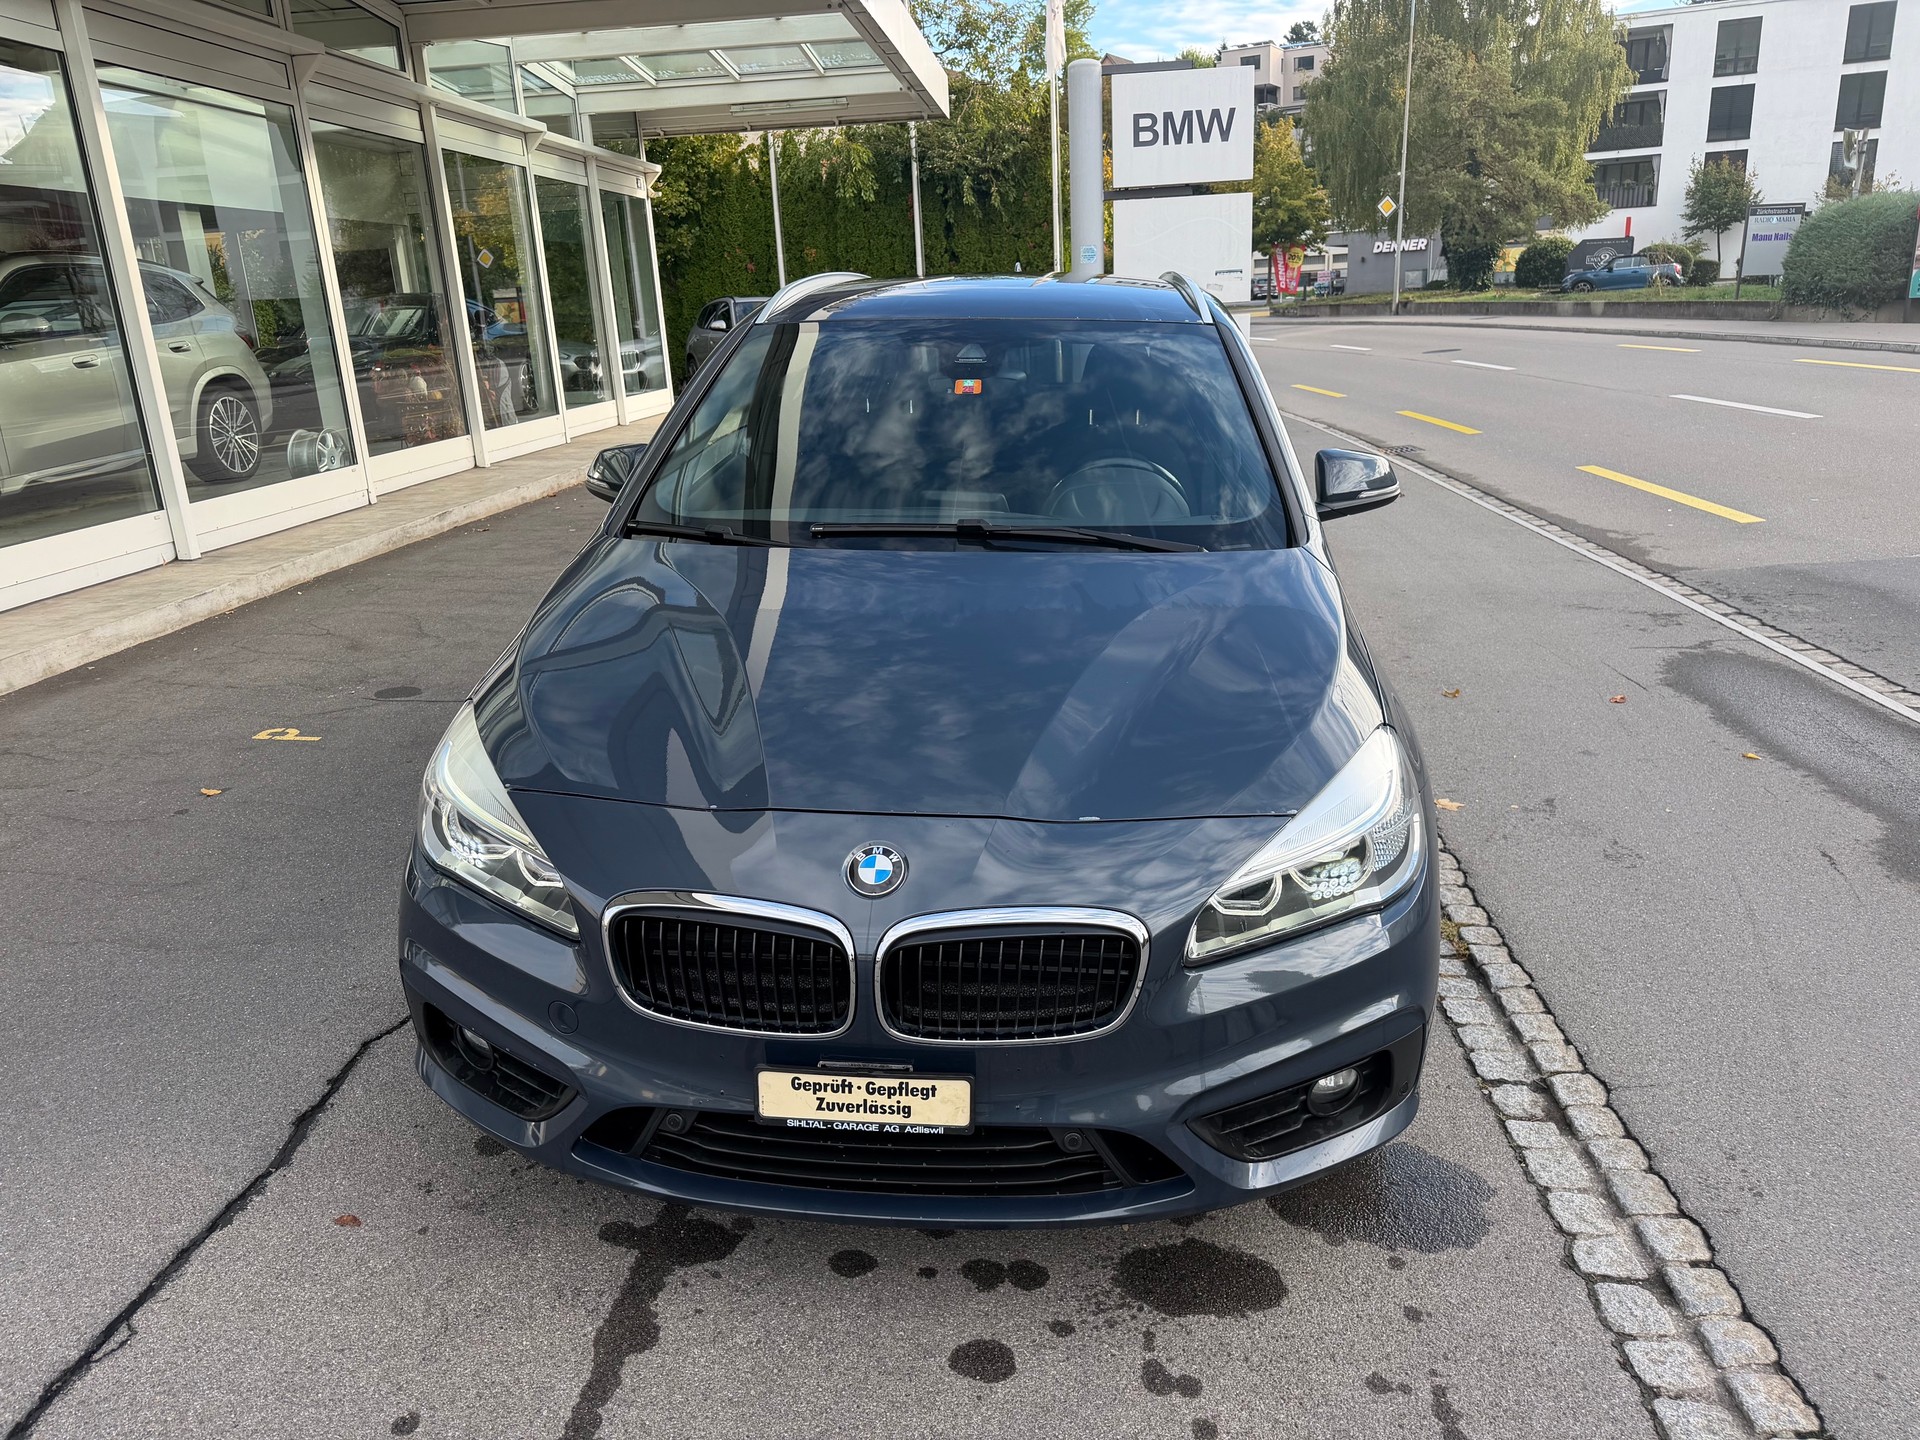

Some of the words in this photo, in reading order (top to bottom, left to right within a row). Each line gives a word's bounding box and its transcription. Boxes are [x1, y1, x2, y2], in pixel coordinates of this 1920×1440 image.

[1132, 107, 1236, 148] BMW
[1373, 238, 1428, 254] DENNER
[1752, 233, 1773, 242] Manu
[1773, 232, 1793, 241] Nails
[1276, 247, 1286, 289] DENNER
[855, 847, 900, 863] BMW
[790, 1076, 854, 1095] Geprüft
[865, 1081, 938, 1101] Gepflegt
[815, 1097, 912, 1118] Zuverlässig
[883, 1123, 900, 1133] AG
[904, 1124, 944, 1135] Adliswil
